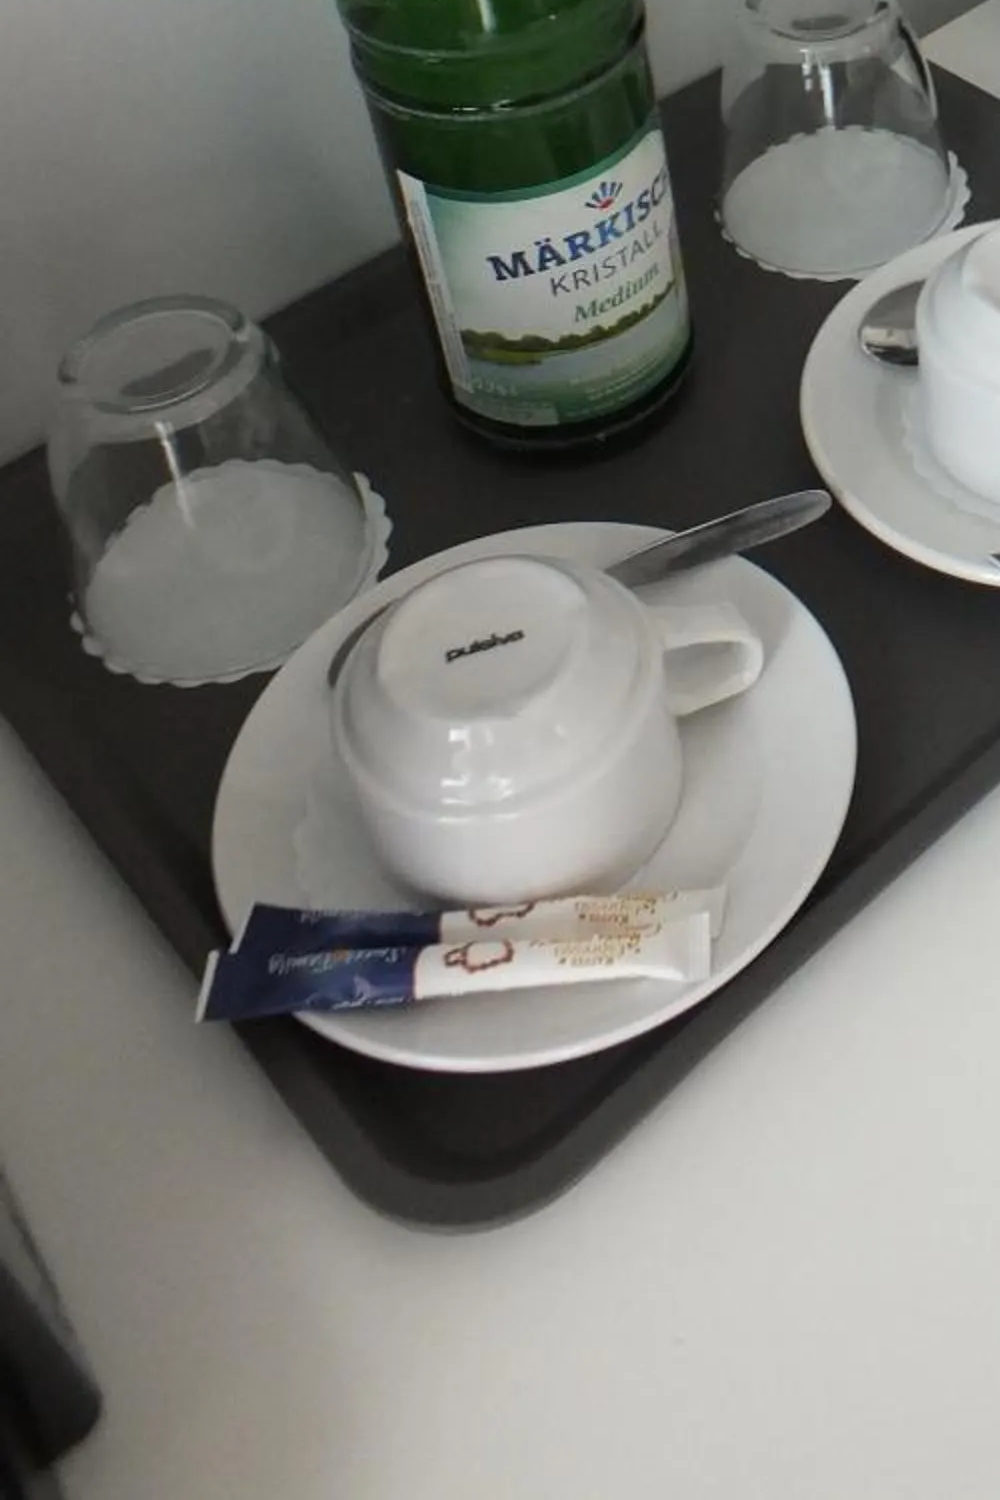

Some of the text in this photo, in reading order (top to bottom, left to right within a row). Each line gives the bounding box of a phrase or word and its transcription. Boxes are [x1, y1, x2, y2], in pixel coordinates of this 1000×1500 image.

[486, 168, 669, 282] MÄRKISC
[550, 219, 662, 298] KRISTALL
[574, 261, 660, 323] Medium
